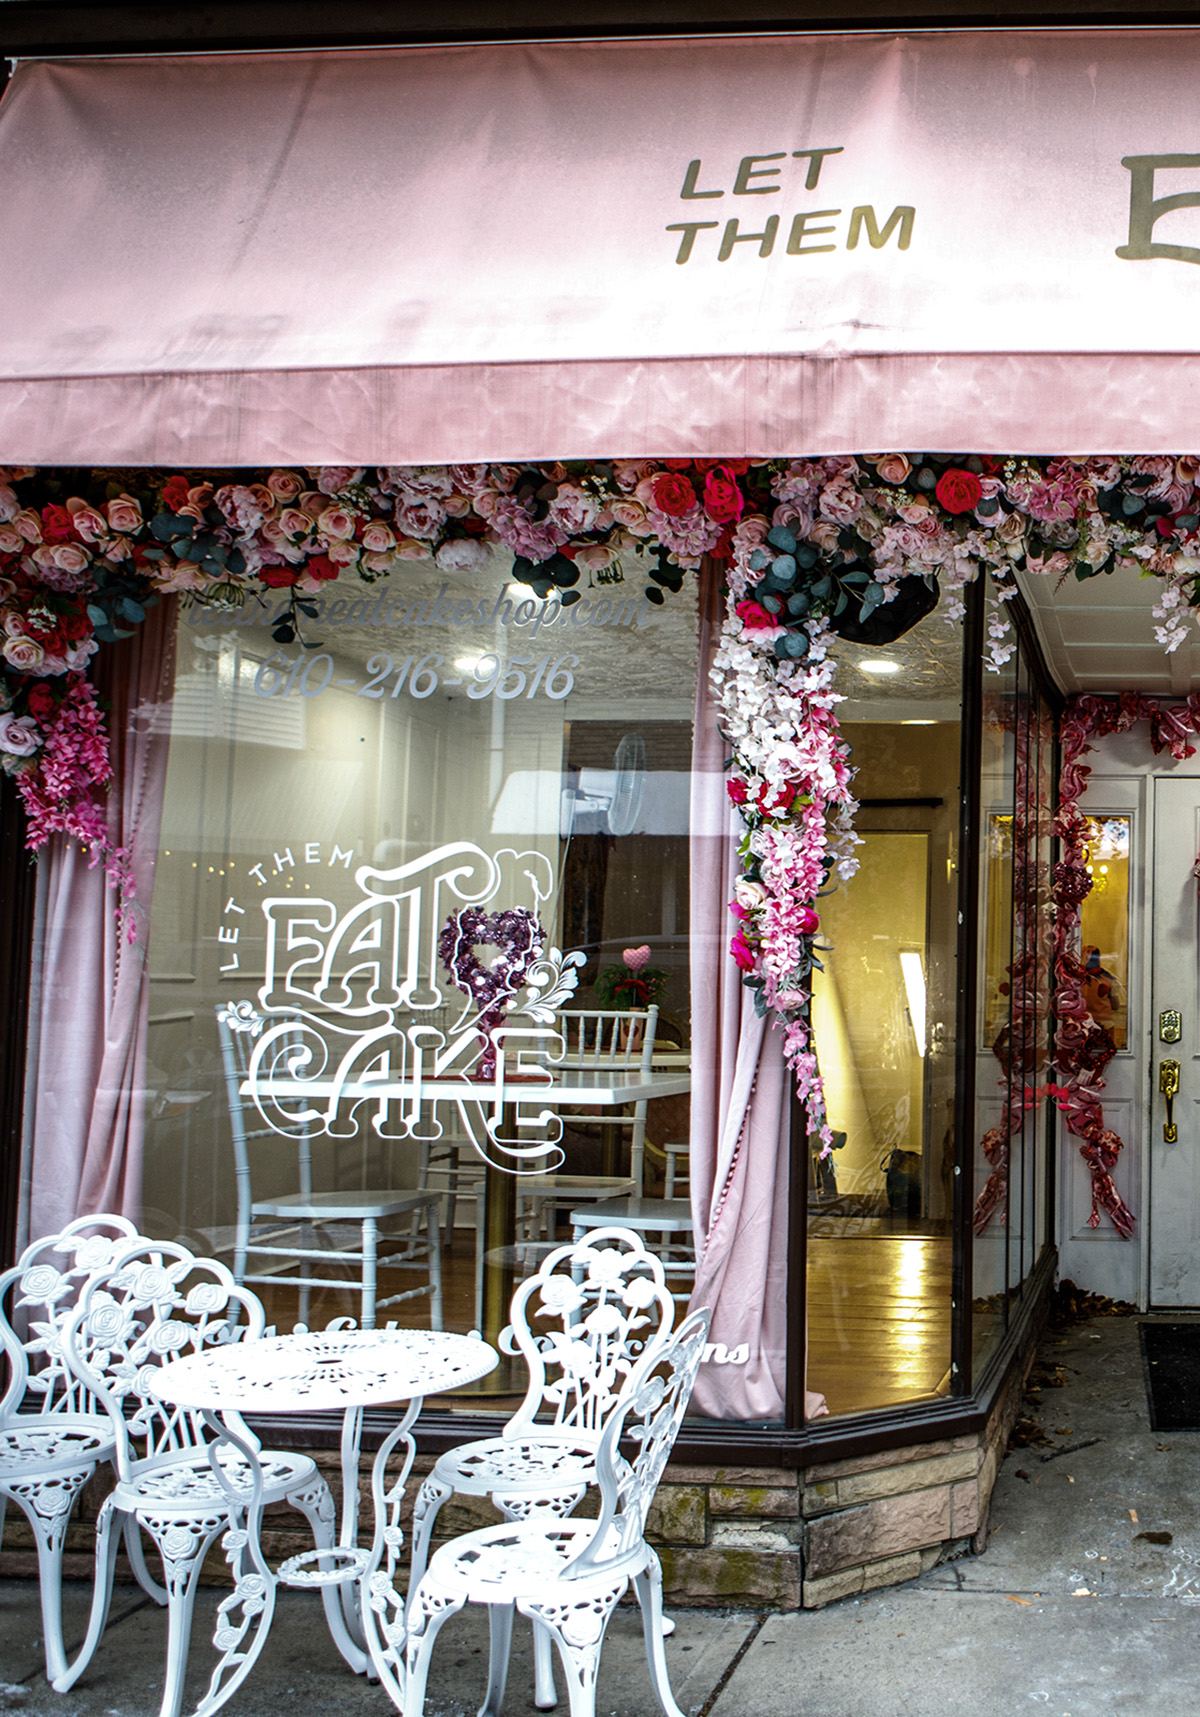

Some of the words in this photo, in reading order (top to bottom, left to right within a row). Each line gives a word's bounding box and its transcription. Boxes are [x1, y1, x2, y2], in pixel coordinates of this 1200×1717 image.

[680, 146, 844, 200] LET
[665, 205, 916, 265] THEM
[253, 652, 578, 700] 610-216-9516
[218, 897, 246, 972] LET
[248, 842, 354, 884] THEM
[258, 841, 496, 1035] EAT
[250, 1022, 566, 1175] CAKE
